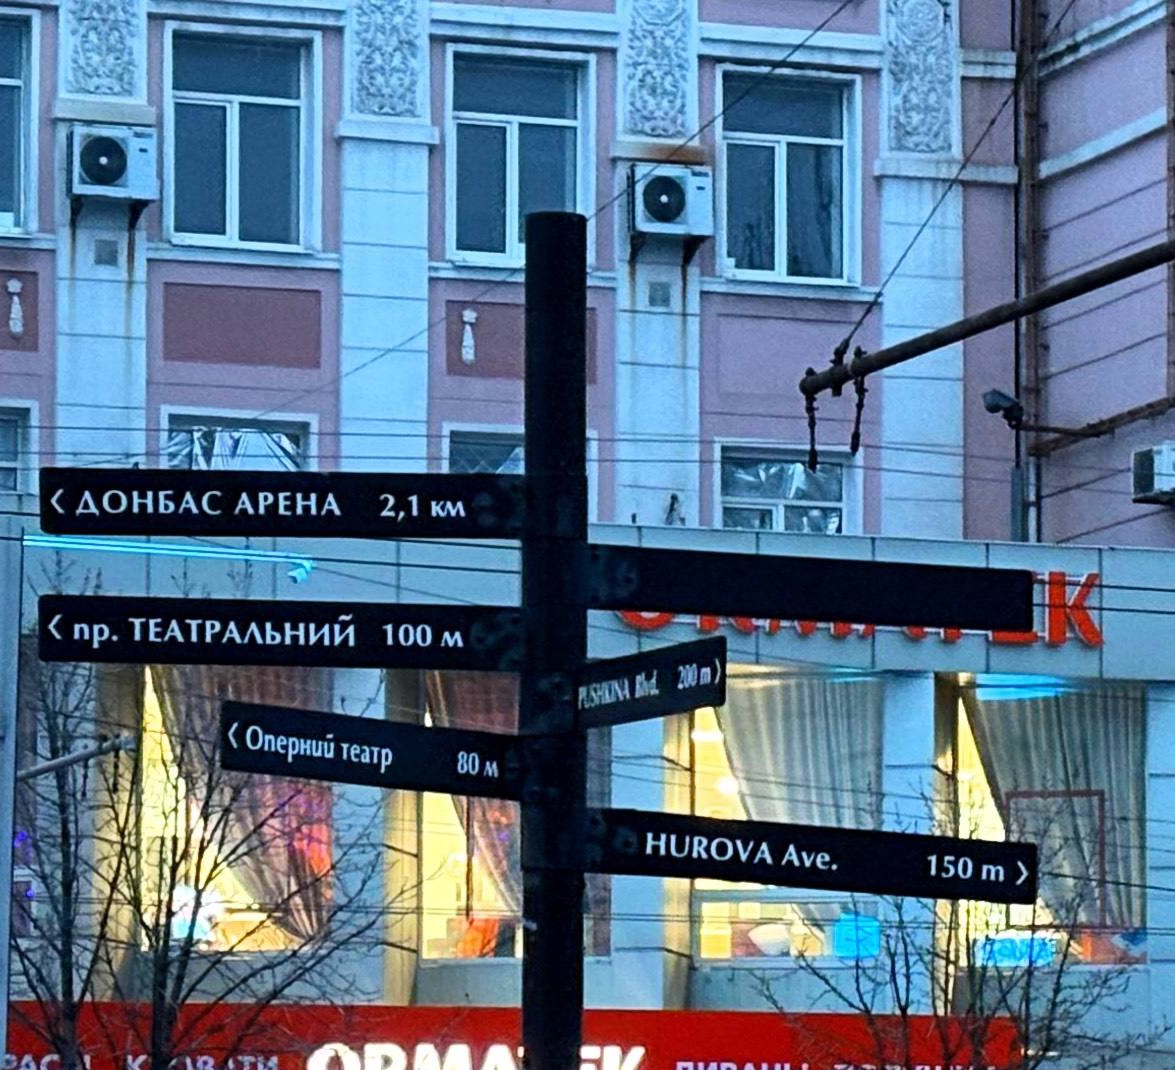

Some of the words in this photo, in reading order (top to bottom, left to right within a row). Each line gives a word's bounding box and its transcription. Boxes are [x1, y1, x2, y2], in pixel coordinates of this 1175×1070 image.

[76, 489, 223, 517] ДОНБАС
[234, 492, 341, 518] АРЕНА
[380, 493, 419, 522] 2,1
[430, 501, 466, 519] км
[73, 623, 119, 649] пр.
[128, 615, 356, 648] ТЕАТРАЛЬНИЙ
[382, 624, 432, 648] 100
[440, 630, 464, 648] м
[578, 677, 631, 710] PUSHKINA
[635, 669, 660, 699] Blvd.
[677, 663, 698, 690] 200
[700, 666, 712, 686] m
[245, 725, 335, 765] Оперний
[340, 743, 394, 771] театр
[457, 752, 480, 776] 80
[483, 761, 500, 779] м
[645, 832, 773, 867] HUROVA
[781, 844, 838, 871] Ave.
[927, 854, 974, 881] 150
[981, 863, 1005, 883] m
